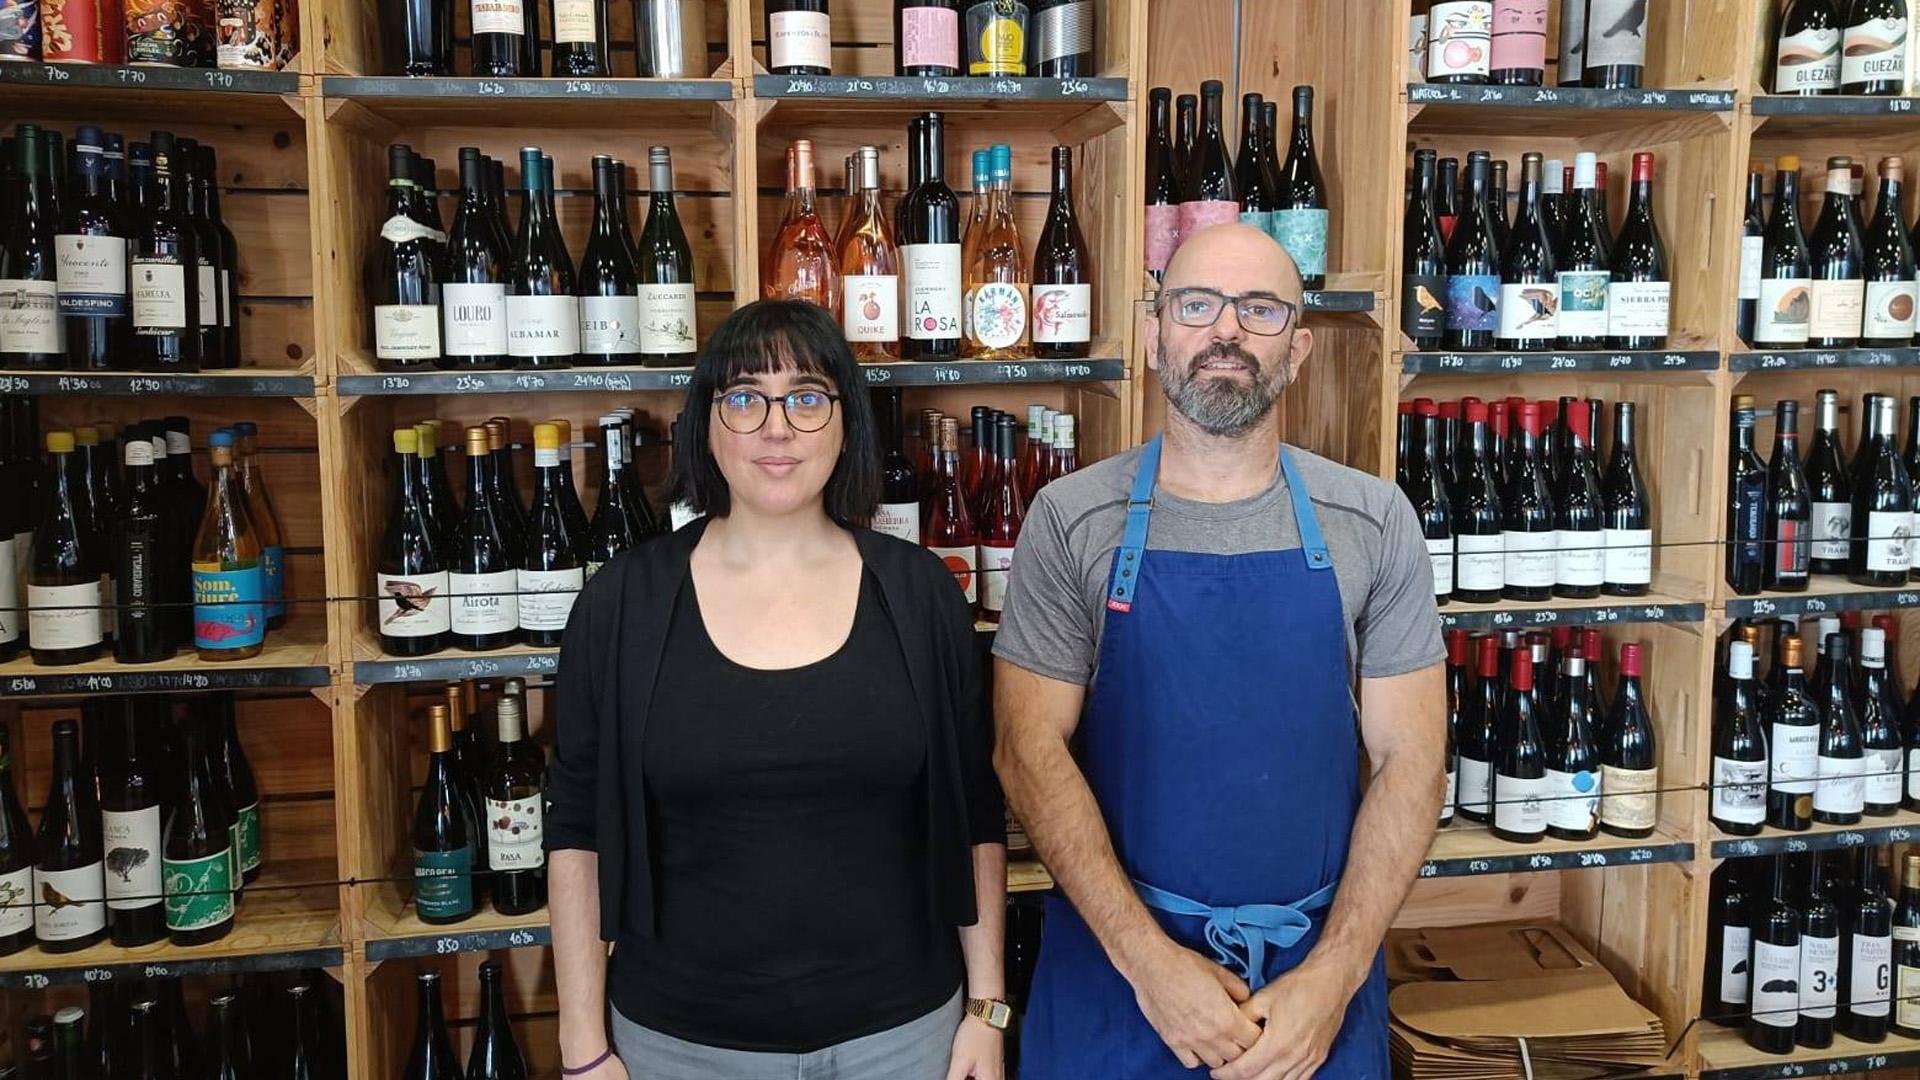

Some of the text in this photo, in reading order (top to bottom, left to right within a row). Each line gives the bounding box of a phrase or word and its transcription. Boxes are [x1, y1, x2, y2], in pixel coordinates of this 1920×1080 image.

[118, 69, 146, 83] 7'70
[204, 71, 233, 87] 7'70
[453, 304, 492, 322] LOURO
[915, 300, 931, 315] LA
[915, 317, 958, 332] ROSA
[436, 937, 459, 954] 8'50
